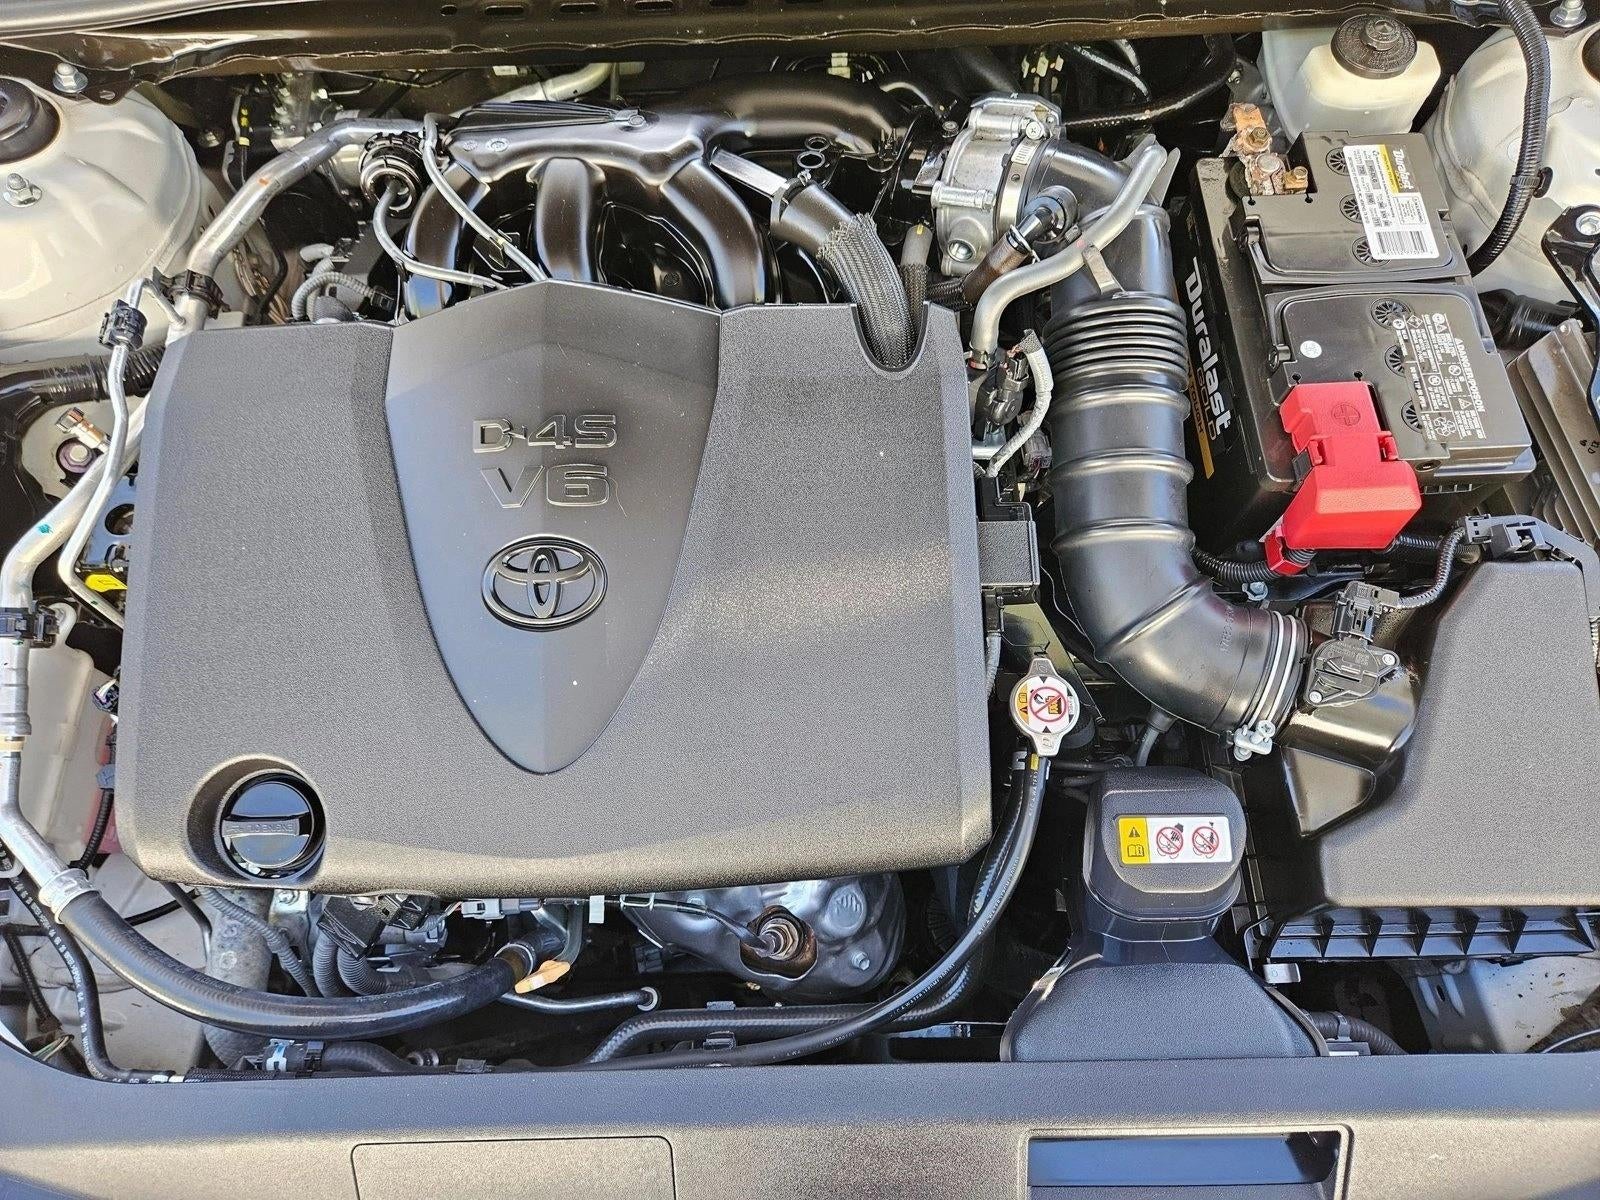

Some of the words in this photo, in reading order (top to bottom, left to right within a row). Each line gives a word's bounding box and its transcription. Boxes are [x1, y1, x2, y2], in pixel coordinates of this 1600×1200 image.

[1392, 149, 1414, 189] Duralast
[1185, 256, 1231, 436] Duralast
[1197, 367, 1217, 440] GOLD
[473, 414, 617, 453] D-4S
[480, 463, 610, 508] V6
